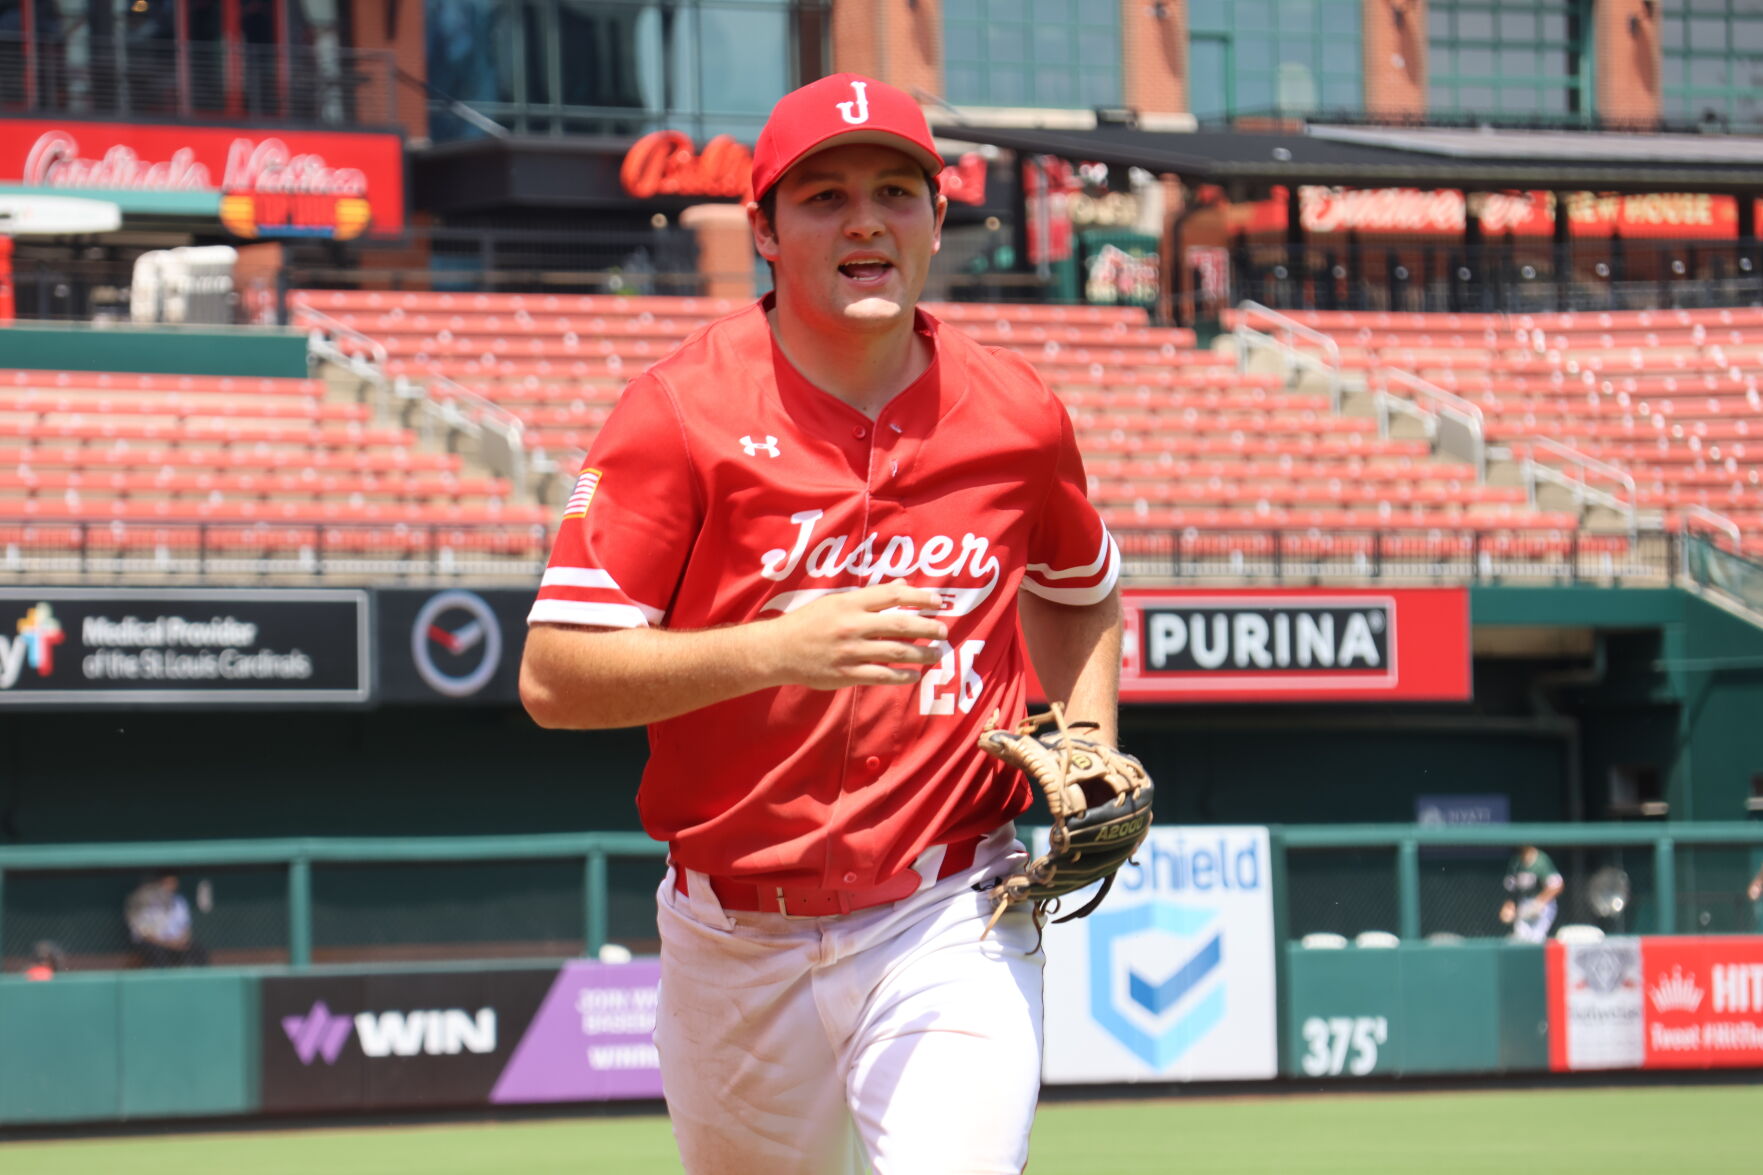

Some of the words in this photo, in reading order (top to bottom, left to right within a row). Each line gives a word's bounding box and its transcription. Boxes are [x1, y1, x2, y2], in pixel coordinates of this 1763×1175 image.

[836, 81, 869, 124] J
[761, 509, 994, 586] Jasper
[82, 616, 164, 646] Medical
[165, 616, 258, 646] Provider
[82, 648, 106, 679] of
[105, 648, 139, 679] the
[164, 648, 219, 679] Louis
[218, 648, 312, 679] Cardinals
[919, 639, 986, 716] 26
[1094, 816, 1145, 843] A2000
[355, 1008, 497, 1057] WIN
[1651, 1021, 1700, 1051] Tweet
